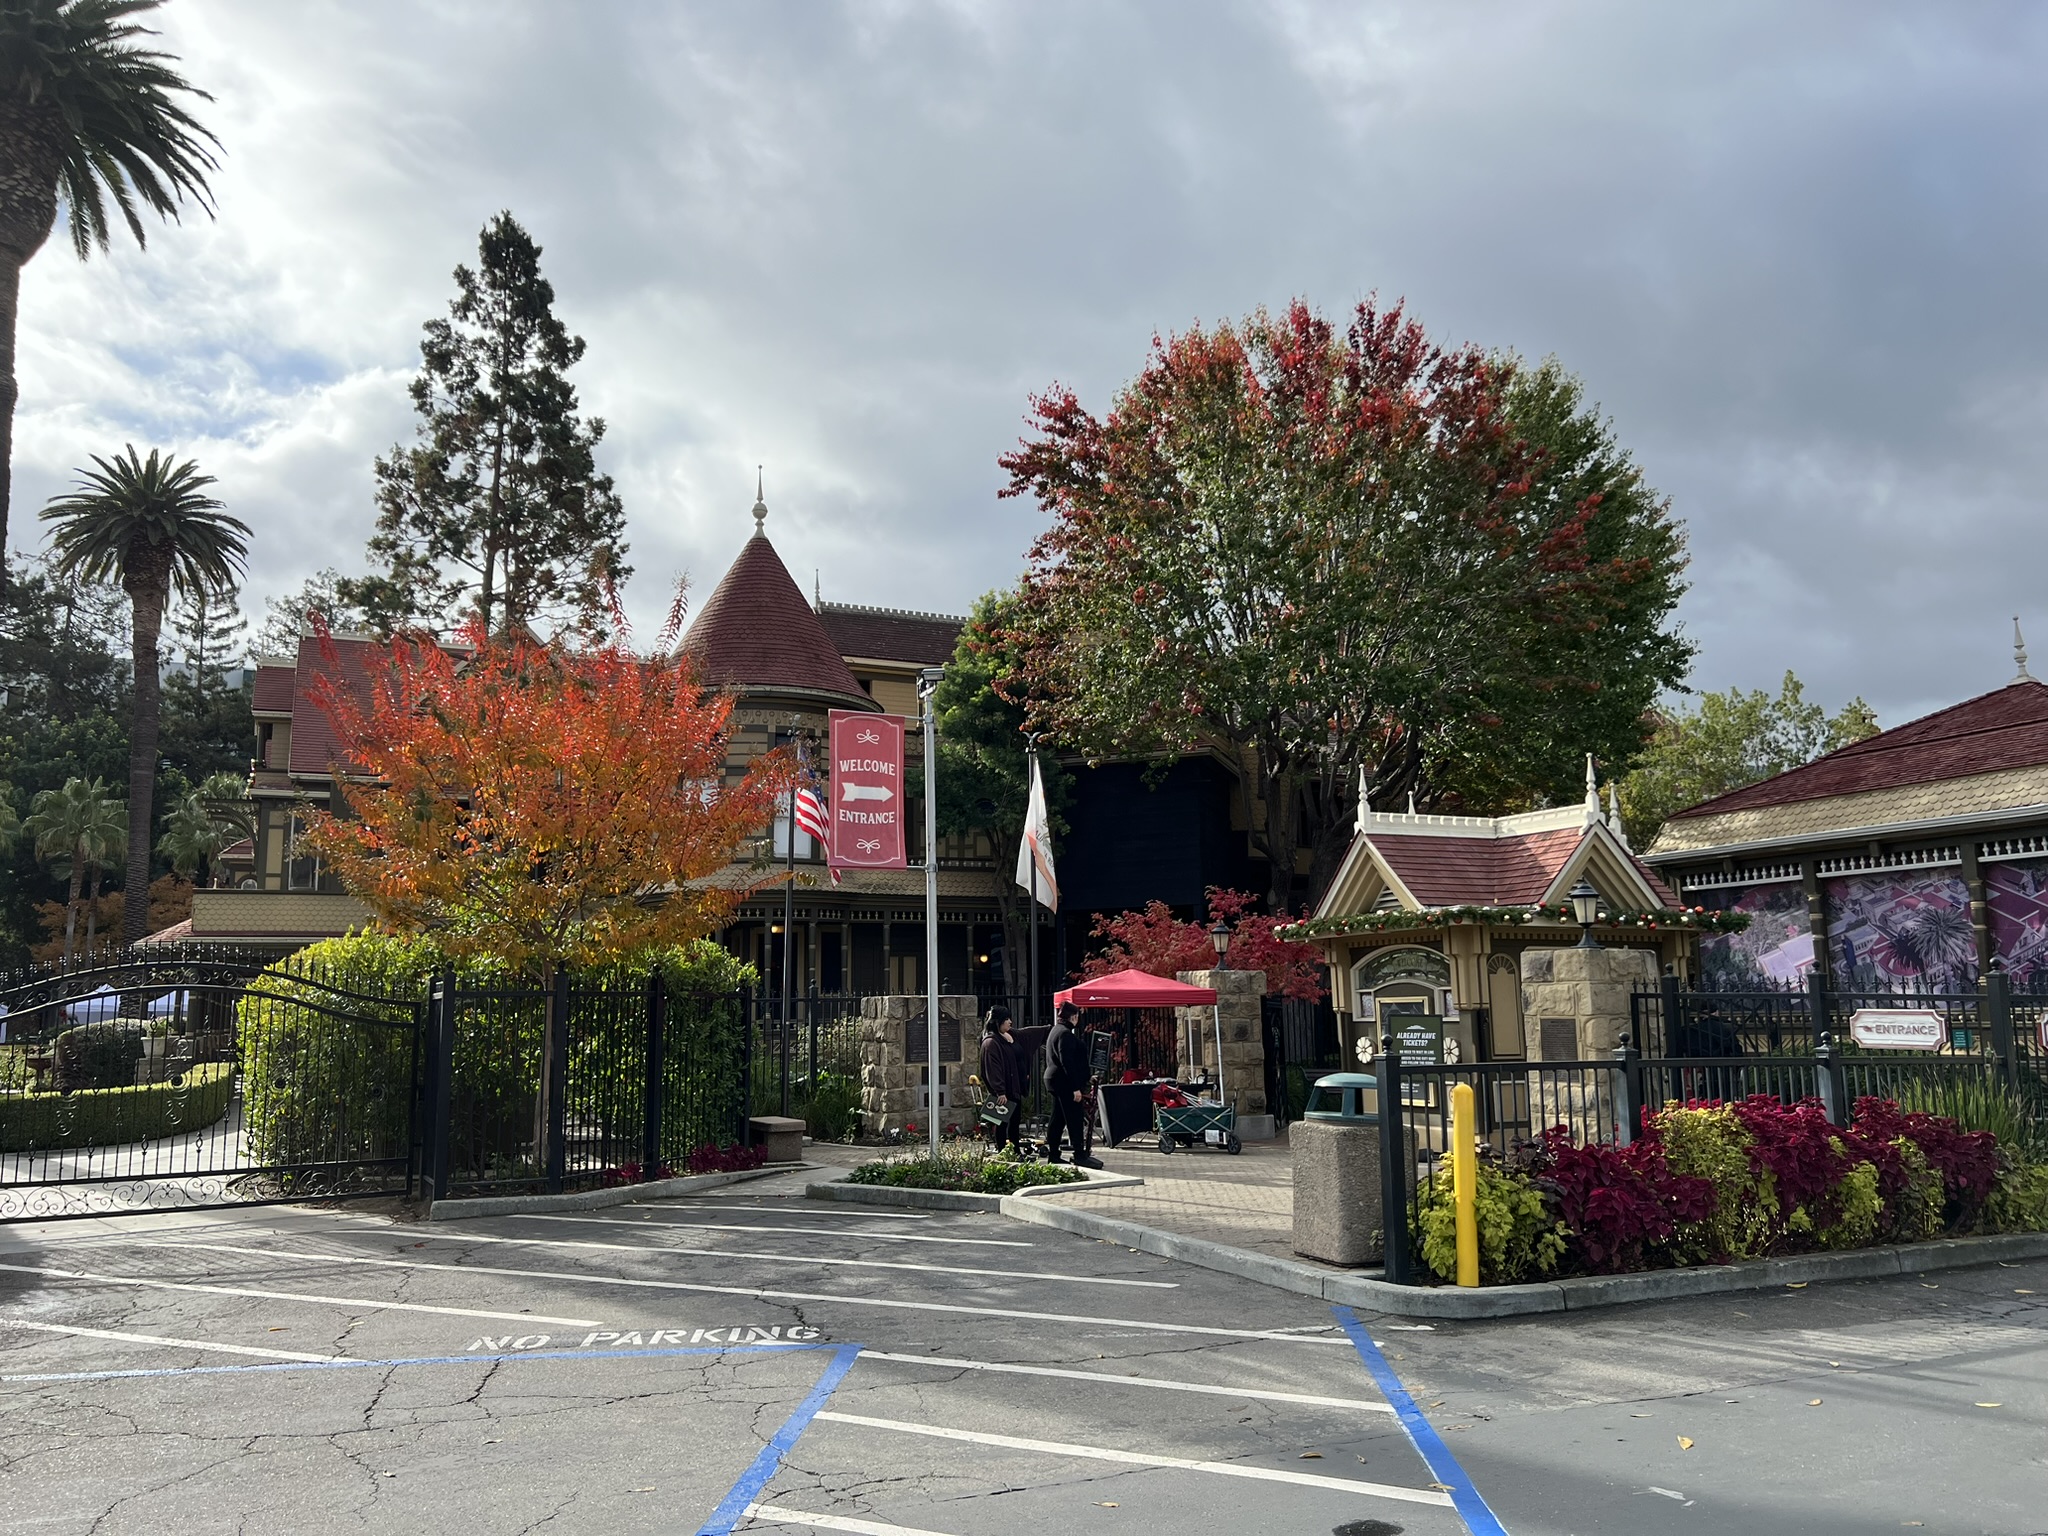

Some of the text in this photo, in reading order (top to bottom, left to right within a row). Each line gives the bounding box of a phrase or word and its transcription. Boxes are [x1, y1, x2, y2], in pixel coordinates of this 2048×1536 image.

[839, 758, 896, 776] WELCOME
[839, 808, 895, 824] ENTRANCE
[1875, 1024, 1936, 1036] ENTRANCE
[467, 1325, 822, 1351] NO PARKING
